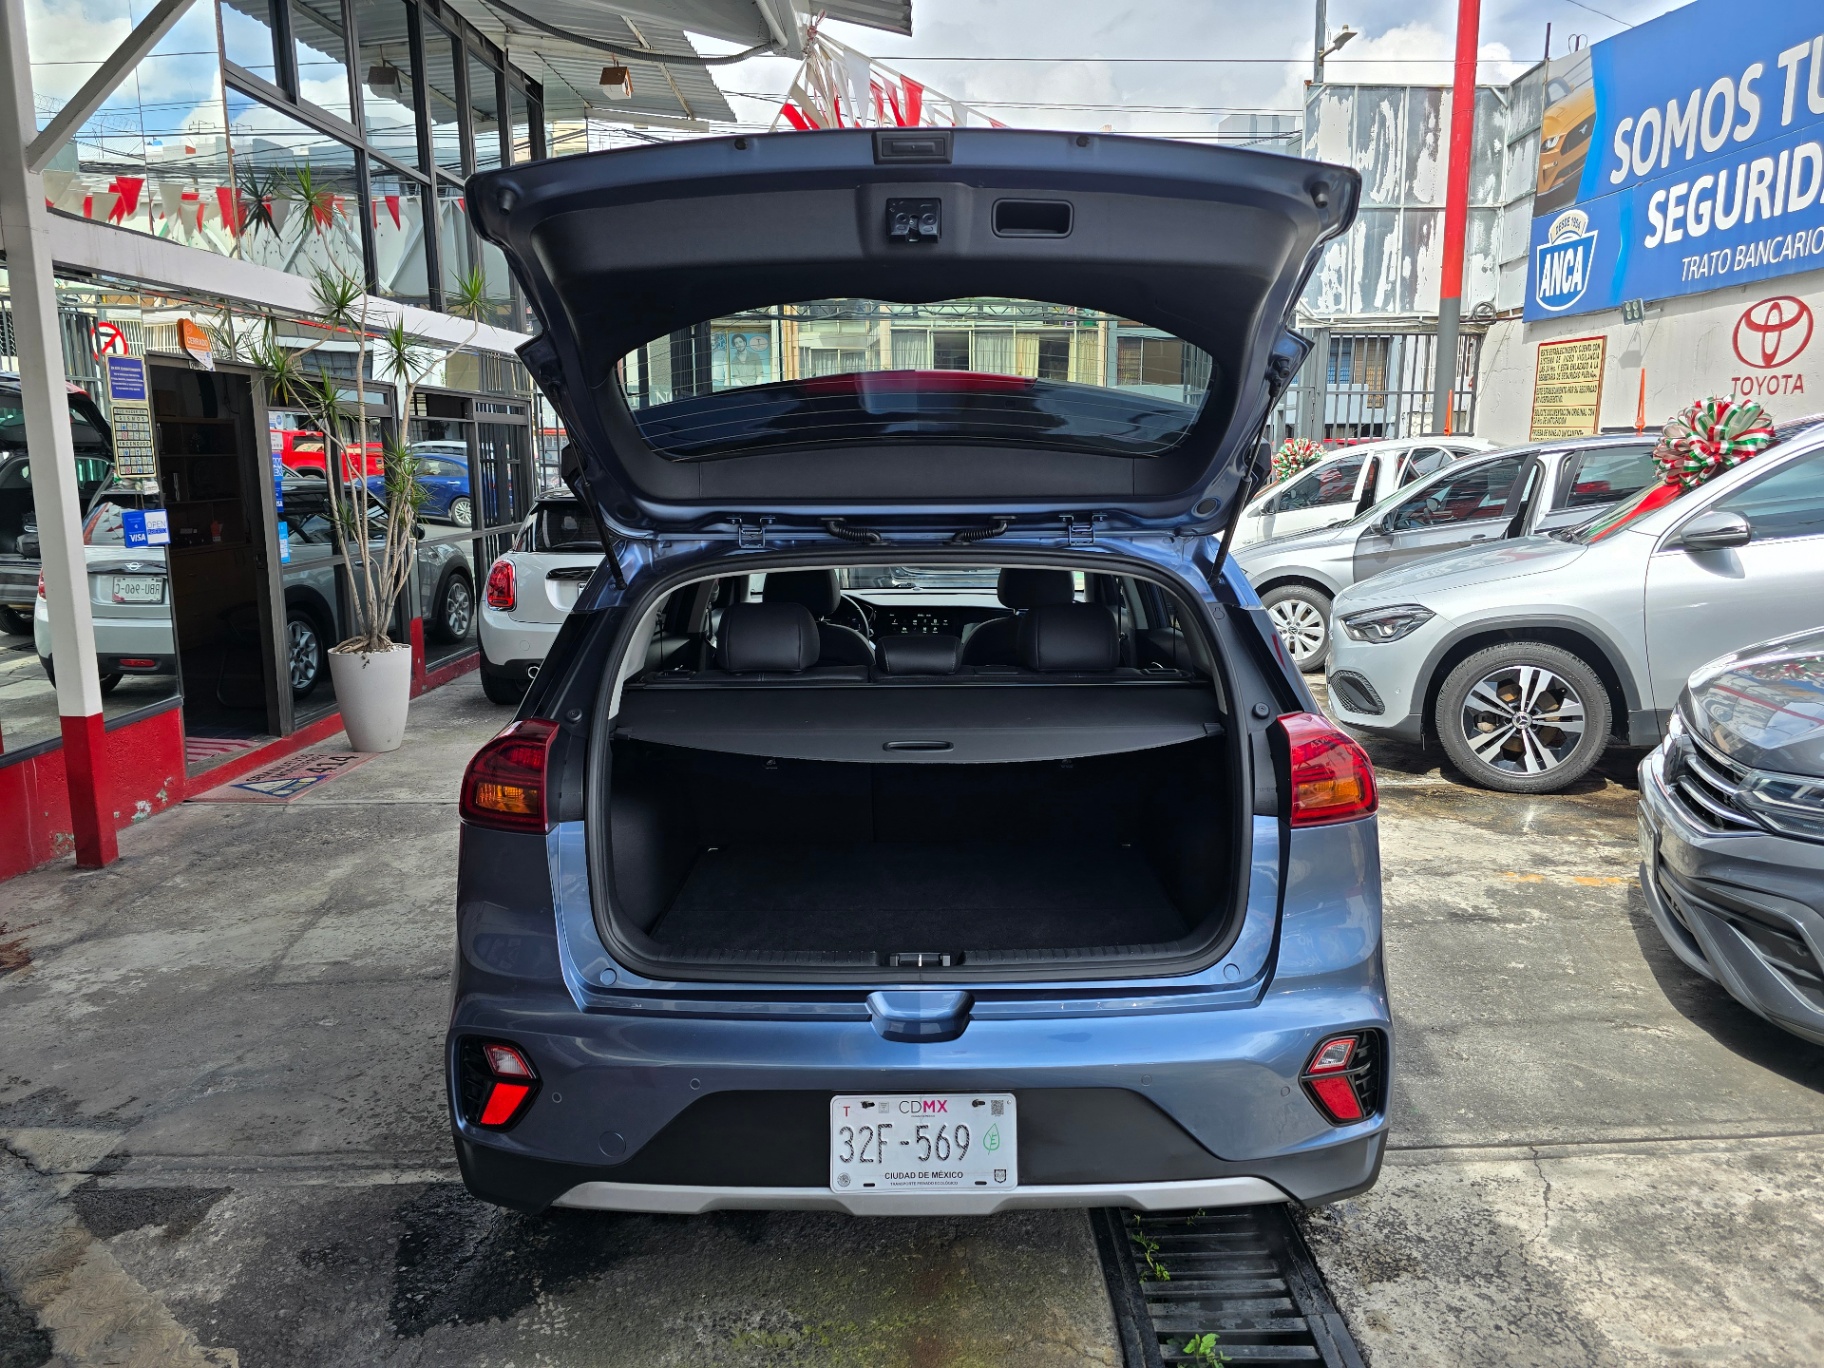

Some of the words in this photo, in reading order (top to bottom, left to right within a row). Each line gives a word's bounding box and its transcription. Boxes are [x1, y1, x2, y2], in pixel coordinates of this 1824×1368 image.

[1609, 63, 1763, 185] SOMOS
[1644, 141, 1824, 249] SEGURID
[1555, 216, 1571, 235] DESDE
[1571, 216, 1582, 231] 1954
[1681, 248, 1732, 282] TRATO
[1733, 226, 1824, 271] BANCARIO
[1539, 245, 1584, 298] ANCA
[1731, 374, 1804, 397] TOYOTA
[147, 521, 166, 529] OPEN
[129, 533, 147, 543] VISA
[843, 1106, 850, 1117] T
[898, 1100, 948, 1114] CDMX
[839, 1123, 970, 1164] 32F-569
[884, 1171, 916, 1180] CIUDAD
[918, 1171, 930, 1179] DE
[931, 1170, 964, 1179] MÉXICO
